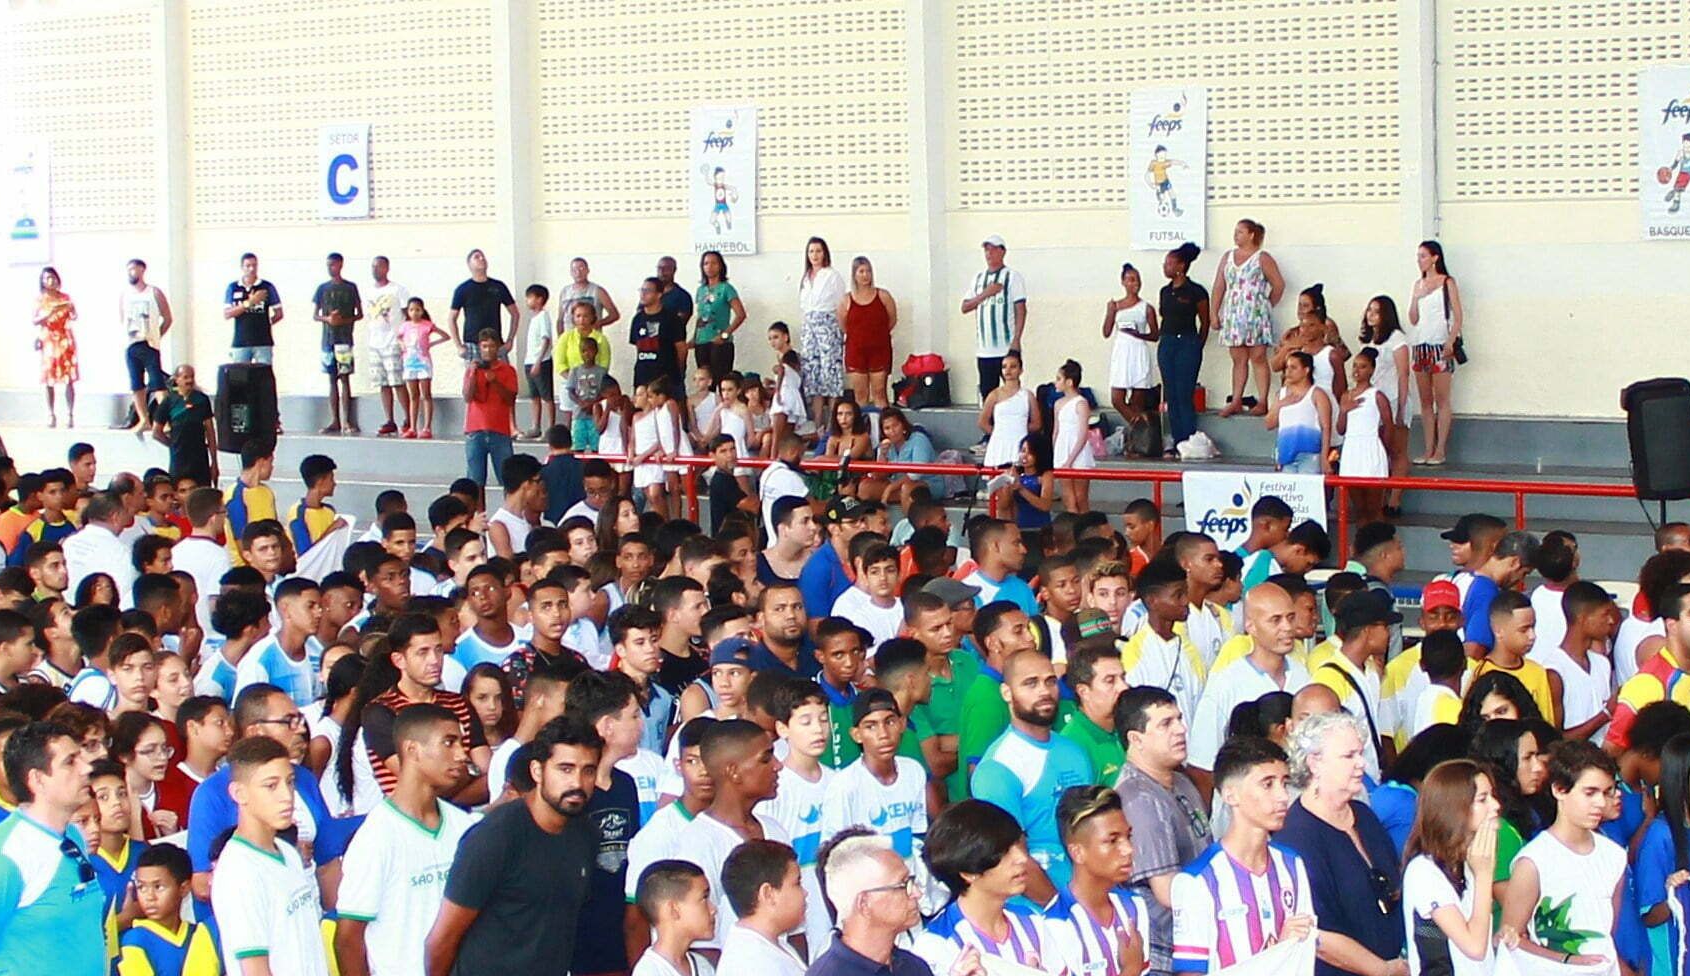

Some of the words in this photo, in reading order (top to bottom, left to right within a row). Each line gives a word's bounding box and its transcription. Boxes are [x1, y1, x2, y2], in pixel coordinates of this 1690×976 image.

[1147, 114, 1183, 137] feeps
[329, 133, 360, 145] SETOR
[702, 131, 734, 154] feeps
[326, 153, 359, 205] C
[1148, 231, 1187, 241] FUTSAL
[694, 241, 751, 253] HANDEBOL
[1259, 482, 1297, 492] Festival
[1196, 508, 1249, 542] feeps
